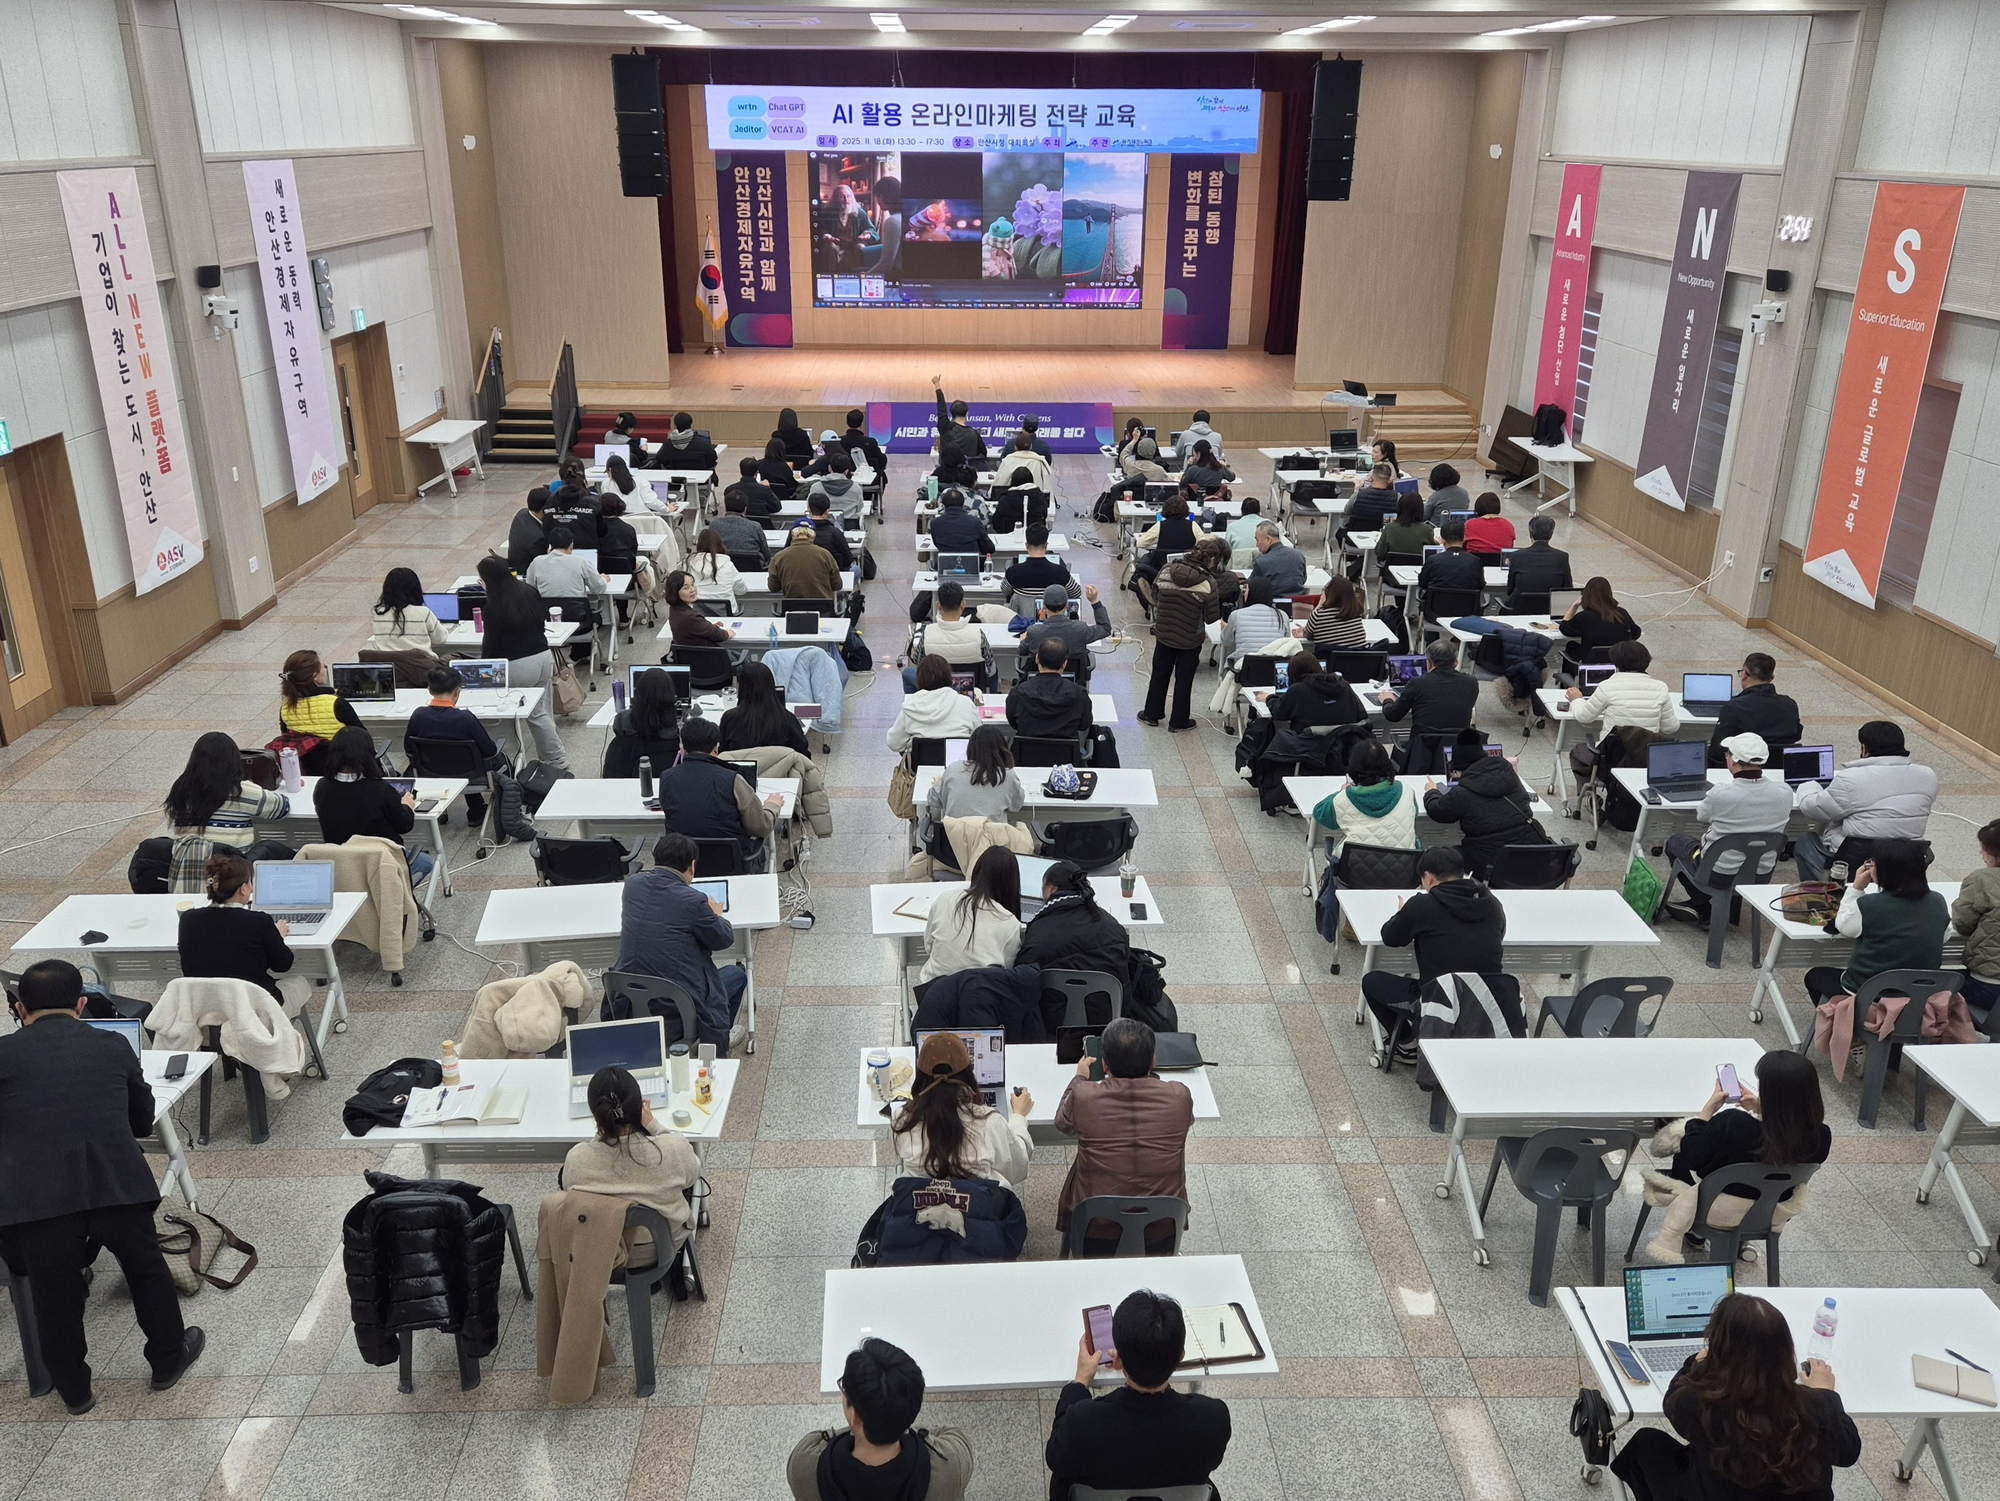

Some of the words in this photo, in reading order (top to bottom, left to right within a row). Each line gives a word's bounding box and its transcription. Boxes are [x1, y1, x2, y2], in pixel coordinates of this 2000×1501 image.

[737, 103, 757, 111] wrtn
[768, 103, 787, 112] Chat
[789, 103, 805, 112] GPT
[832, 104, 853, 124] AI
[861, 102, 902, 127] 활용
[911, 103, 1037, 128] 온라인마케팅
[1047, 103, 1088, 128] 전략
[1095, 103, 1136, 128] 교육
[735, 125, 762, 134] Jeditor
[771, 126, 794, 134] VCAT
[796, 126, 804, 134] AI
[841, 137, 862, 146] 2025.
[897, 138, 916, 146] 13:30
[925, 138, 944, 146] 17:30
[1185, 170, 1202, 221] 변화를
[1208, 170, 1225, 204] 참된
[756, 167, 775, 252] 안산시민과
[1205, 211, 1221, 244] 동행
[1565, 193, 1582, 238] A
[274, 178, 293, 252] 새로운
[288, 264, 302, 311] 동력
[734, 167, 756, 302] 안산경제자유구역
[1182, 228, 1199, 277] 꿈꾸는
[1690, 207, 1718, 260] N
[760, 259, 777, 292] 함께
[1677, 271, 1689, 283] New
[1688, 273, 1716, 291] Opportunity
[1886, 228, 1922, 294] S
[265, 211, 308, 418] 안산경제자유구역
[1561, 278, 1572, 321] 새로운
[108, 192, 133, 280] ALL
[127, 293, 152, 379] NEW
[145, 389, 172, 475] 플랫폼
[1557, 325, 1566, 354] 첨단
[1681, 308, 1695, 359] 새로운
[1858, 308, 1890, 325] Superior
[1889, 313, 1926, 333] Education
[91, 231, 119, 316] 기업이
[112, 327, 131, 385] 찾는
[125, 394, 146, 457] 도시,
[139, 471, 158, 524] 안산
[1672, 364, 1686, 414] 일자리
[1868, 355, 1889, 418] 새로운
[894, 426, 929, 438] 시민과
[995, 413, 1016, 422] With
[1063, 427, 1086, 438] 열다
[1855, 424, 1874, 487] 글로벌
[1844, 493, 1860, 533] 교육
[931, 1179, 951, 1188] Jeep
